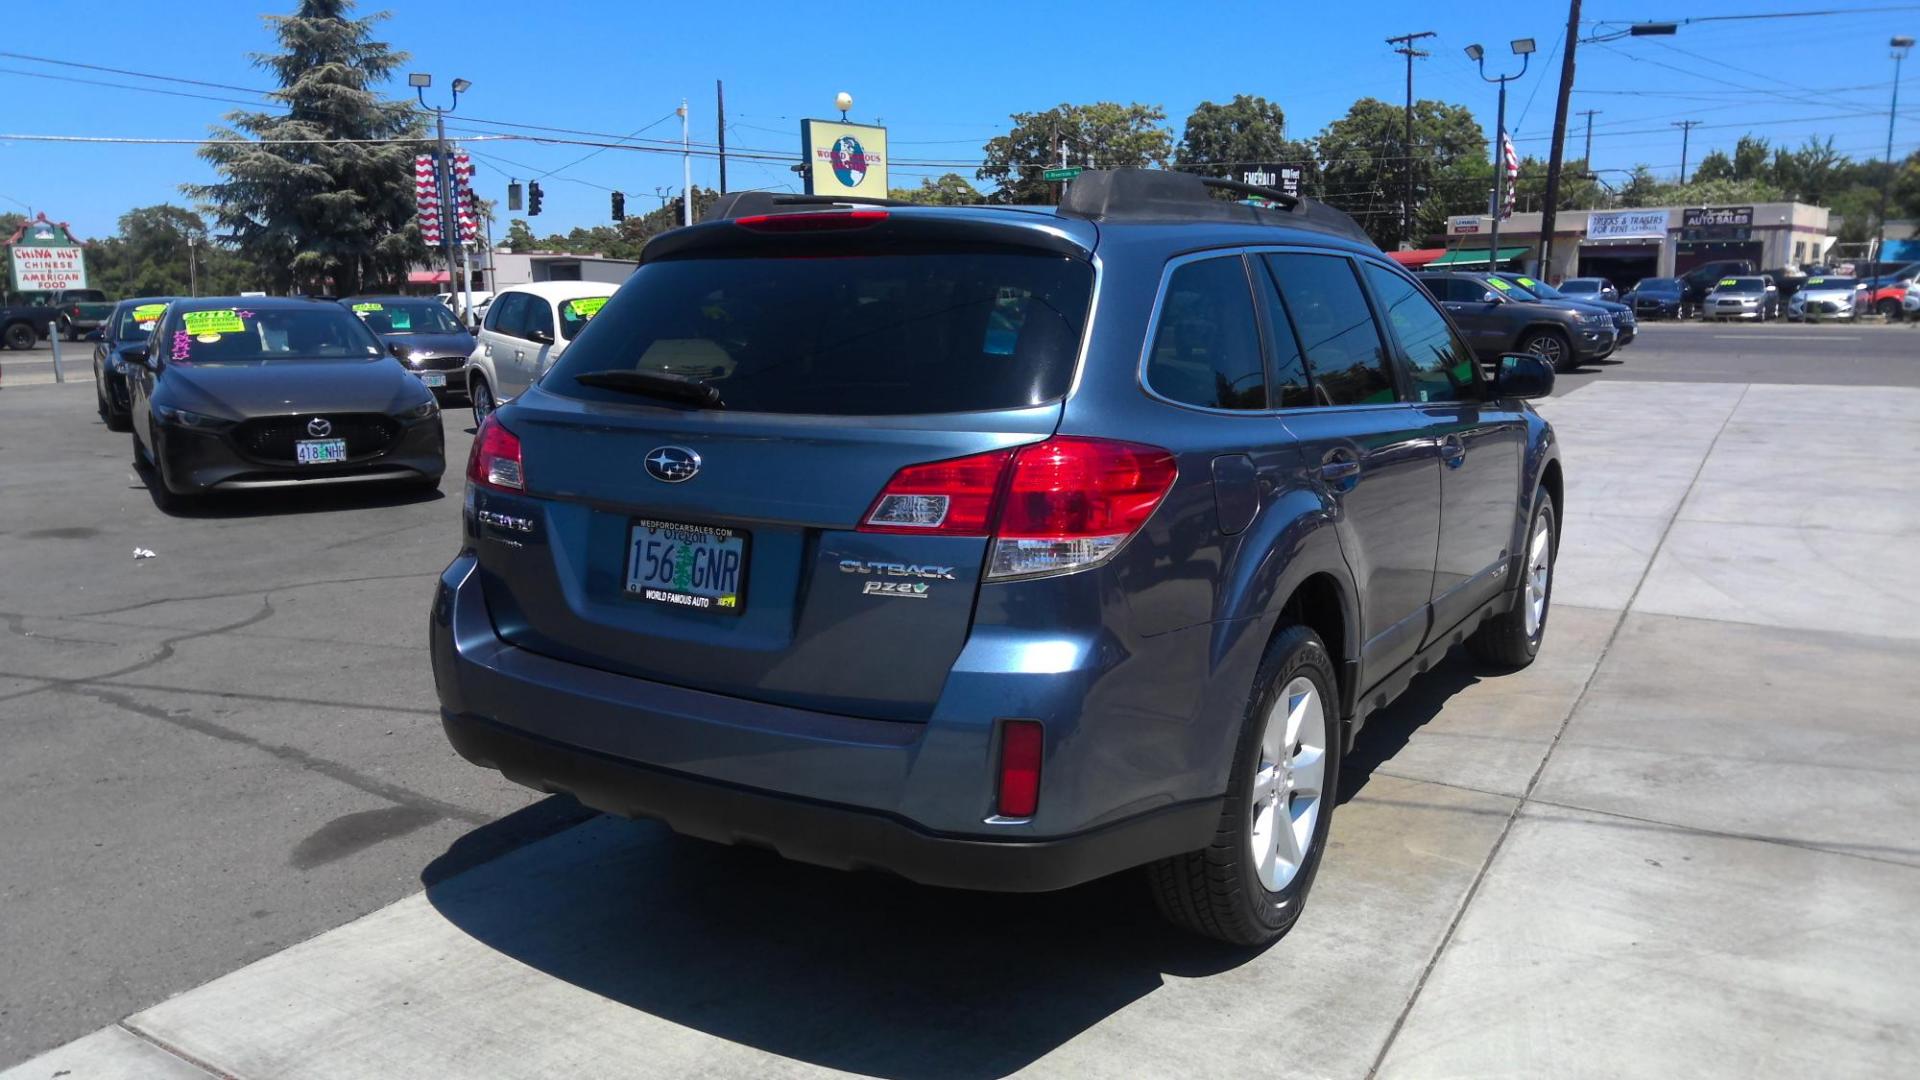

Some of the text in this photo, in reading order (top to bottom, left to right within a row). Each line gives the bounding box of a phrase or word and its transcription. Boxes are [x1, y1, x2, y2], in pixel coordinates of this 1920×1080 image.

[1244, 171, 1276, 186] EMERALD
[1593, 216, 1618, 226] TRUCKS
[1630, 215, 1664, 225] TRAILERS
[1687, 215, 1748, 226] AUTO SALES
[1592, 225, 1606, 234] FOR
[1609, 225, 1629, 234] RENT
[14, 248, 79, 259] CHINA HUT
[24, 261, 73, 269] CHINESE
[22, 273, 79, 281] AMERICAN
[38, 281, 66, 289] FOOD
[299, 444, 345, 460] 418 NHH
[640, 519, 733, 537] MEDFORDCARSALES.COM
[663, 528, 707, 546] Oregon
[634, 540, 738, 593] 156 GNR
[839, 560, 955, 580] OUTBACK
[645, 589, 666, 602] WORLD
[667, 592, 692, 606] FAMOUS
[691, 595, 710, 608] AUTO
